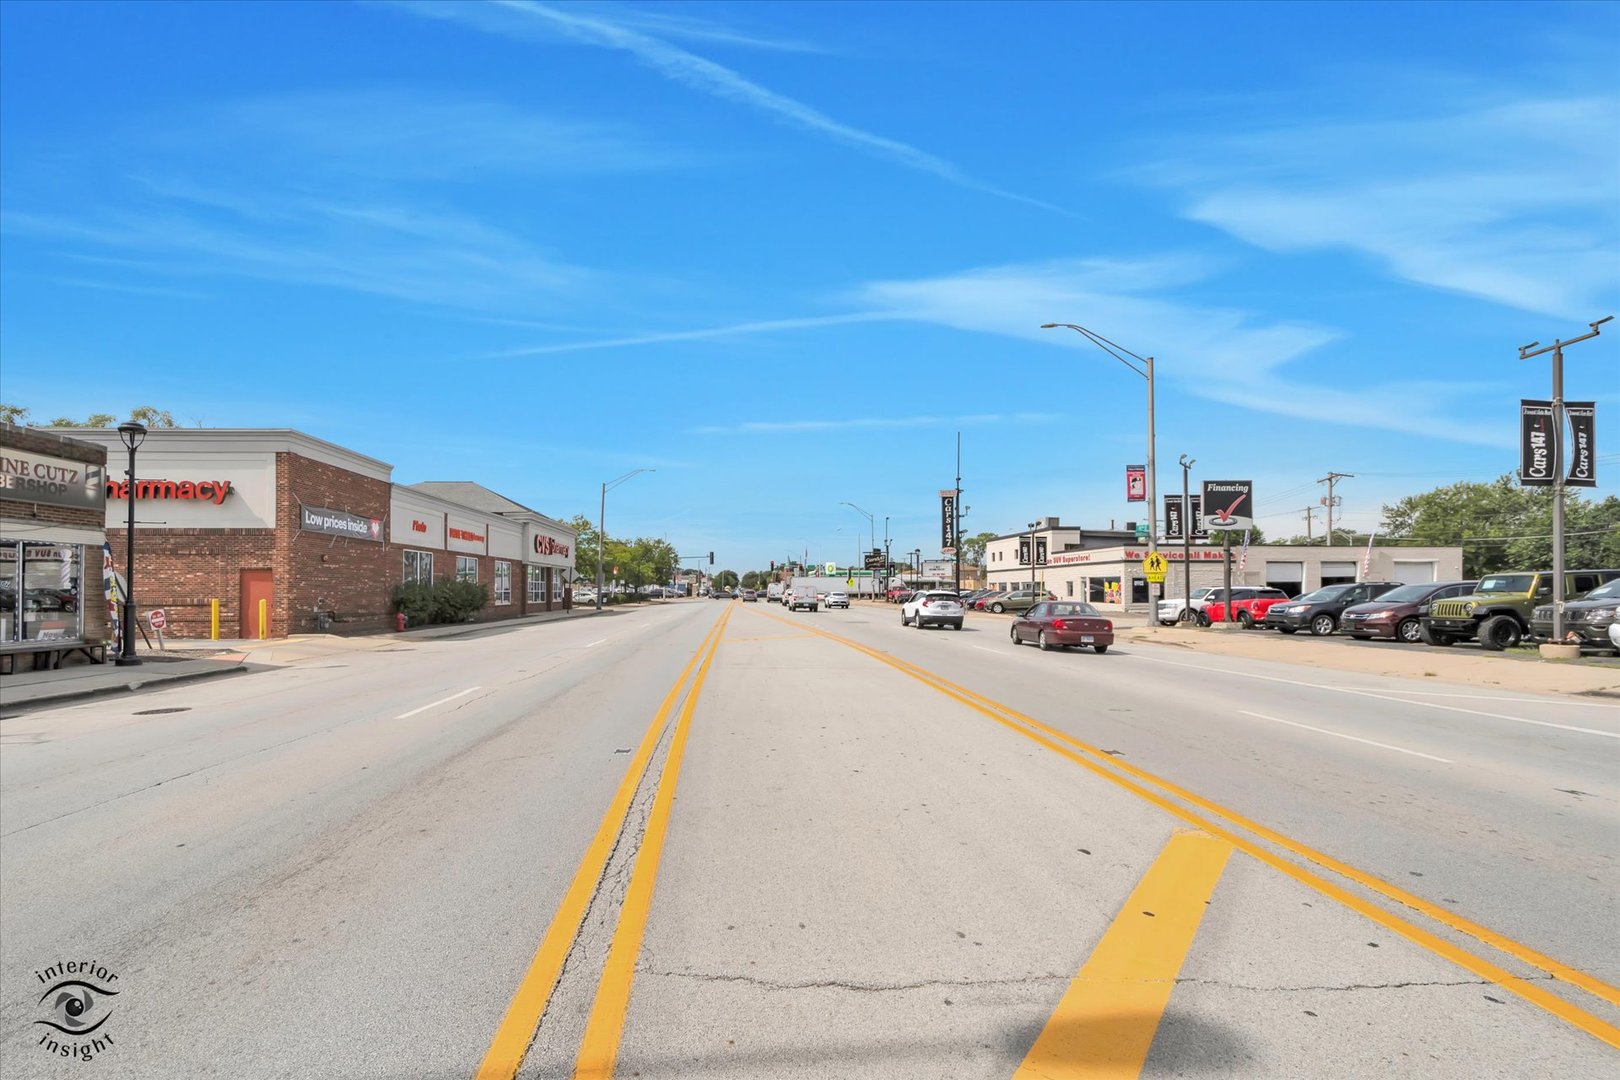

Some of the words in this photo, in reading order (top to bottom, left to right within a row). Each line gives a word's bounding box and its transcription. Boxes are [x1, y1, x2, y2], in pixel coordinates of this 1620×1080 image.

[33, 463, 79, 485] CUTZ
[1207, 483, 1249, 494] Financing
[305, 510, 323, 526] Low
[324, 515, 347, 530] prices
[347, 518, 368, 533] inside
[534, 534, 552, 555] CVS
[1125, 551, 1140, 559] We
[1203, 551, 1236, 559] Maks
